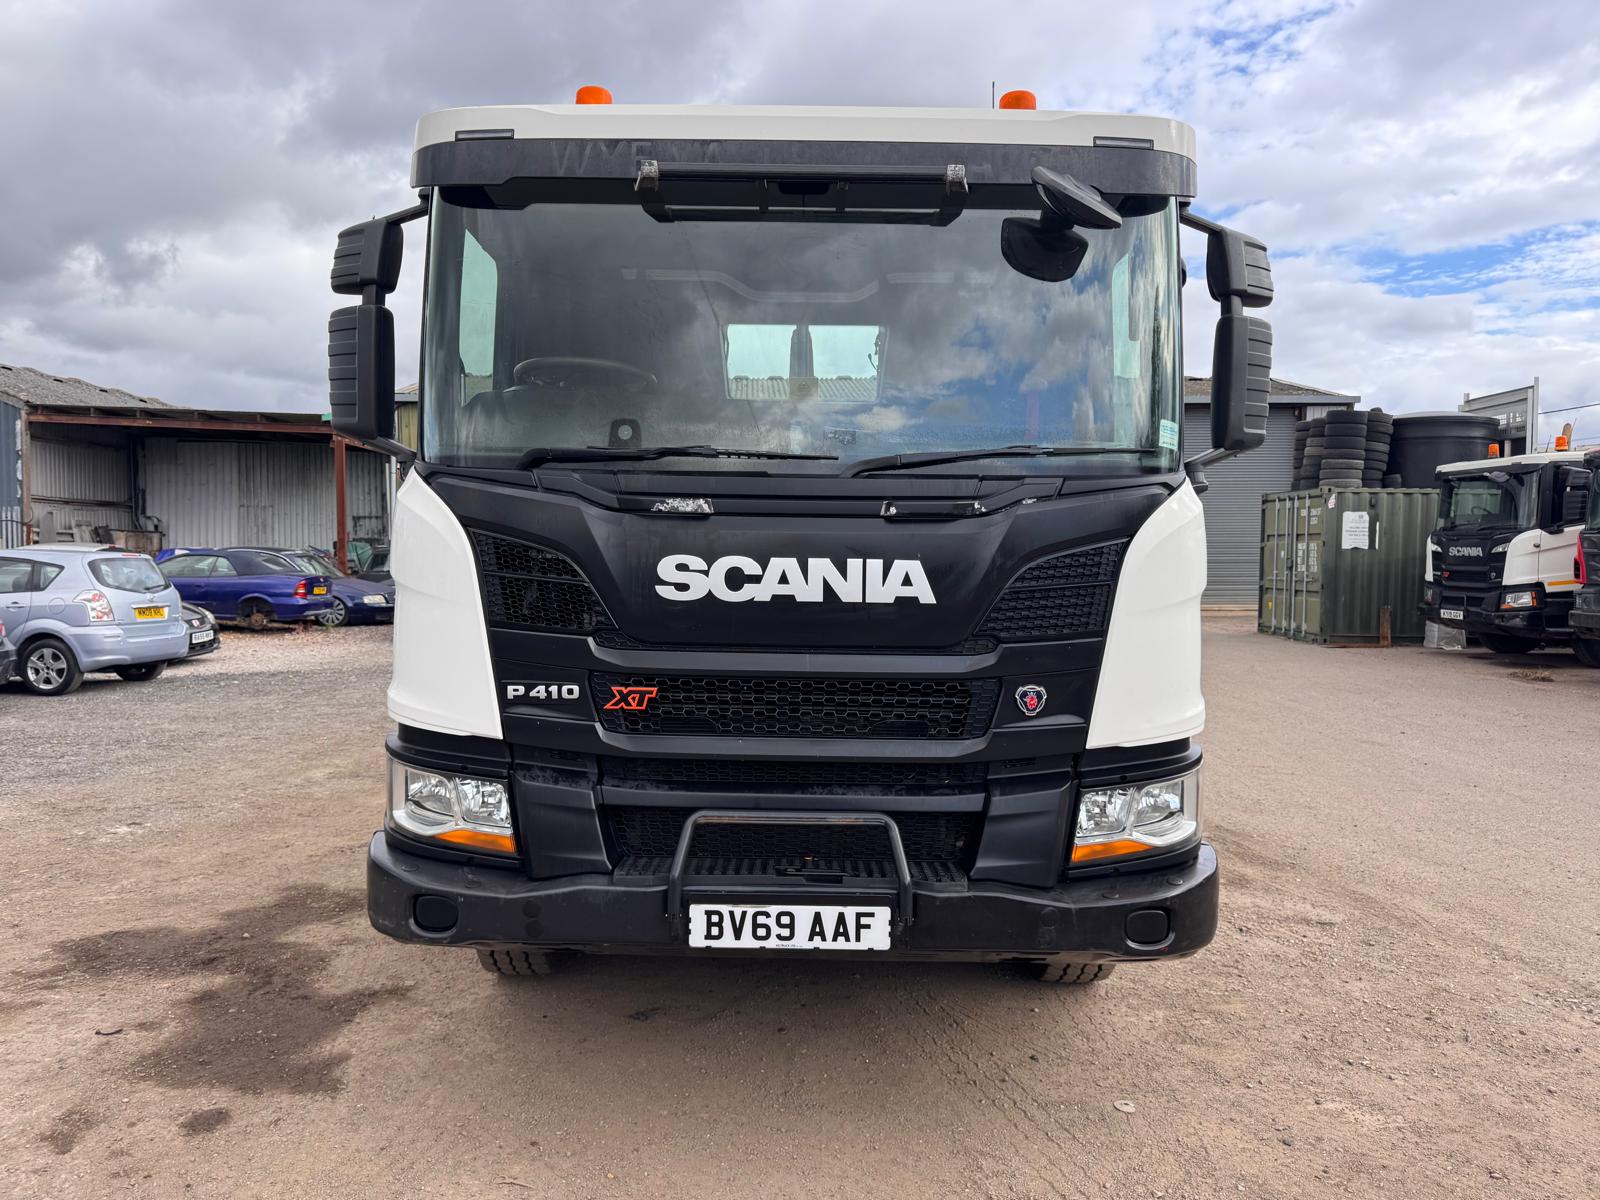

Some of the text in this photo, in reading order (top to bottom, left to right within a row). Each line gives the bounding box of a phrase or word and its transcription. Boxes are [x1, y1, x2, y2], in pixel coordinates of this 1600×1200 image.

[1448, 546, 1483, 557] SCANIA
[654, 554, 937, 604] SCANIA
[507, 685, 580, 699] P 410
[603, 686, 658, 710] XT
[704, 909, 876, 943] BV69 AAF
